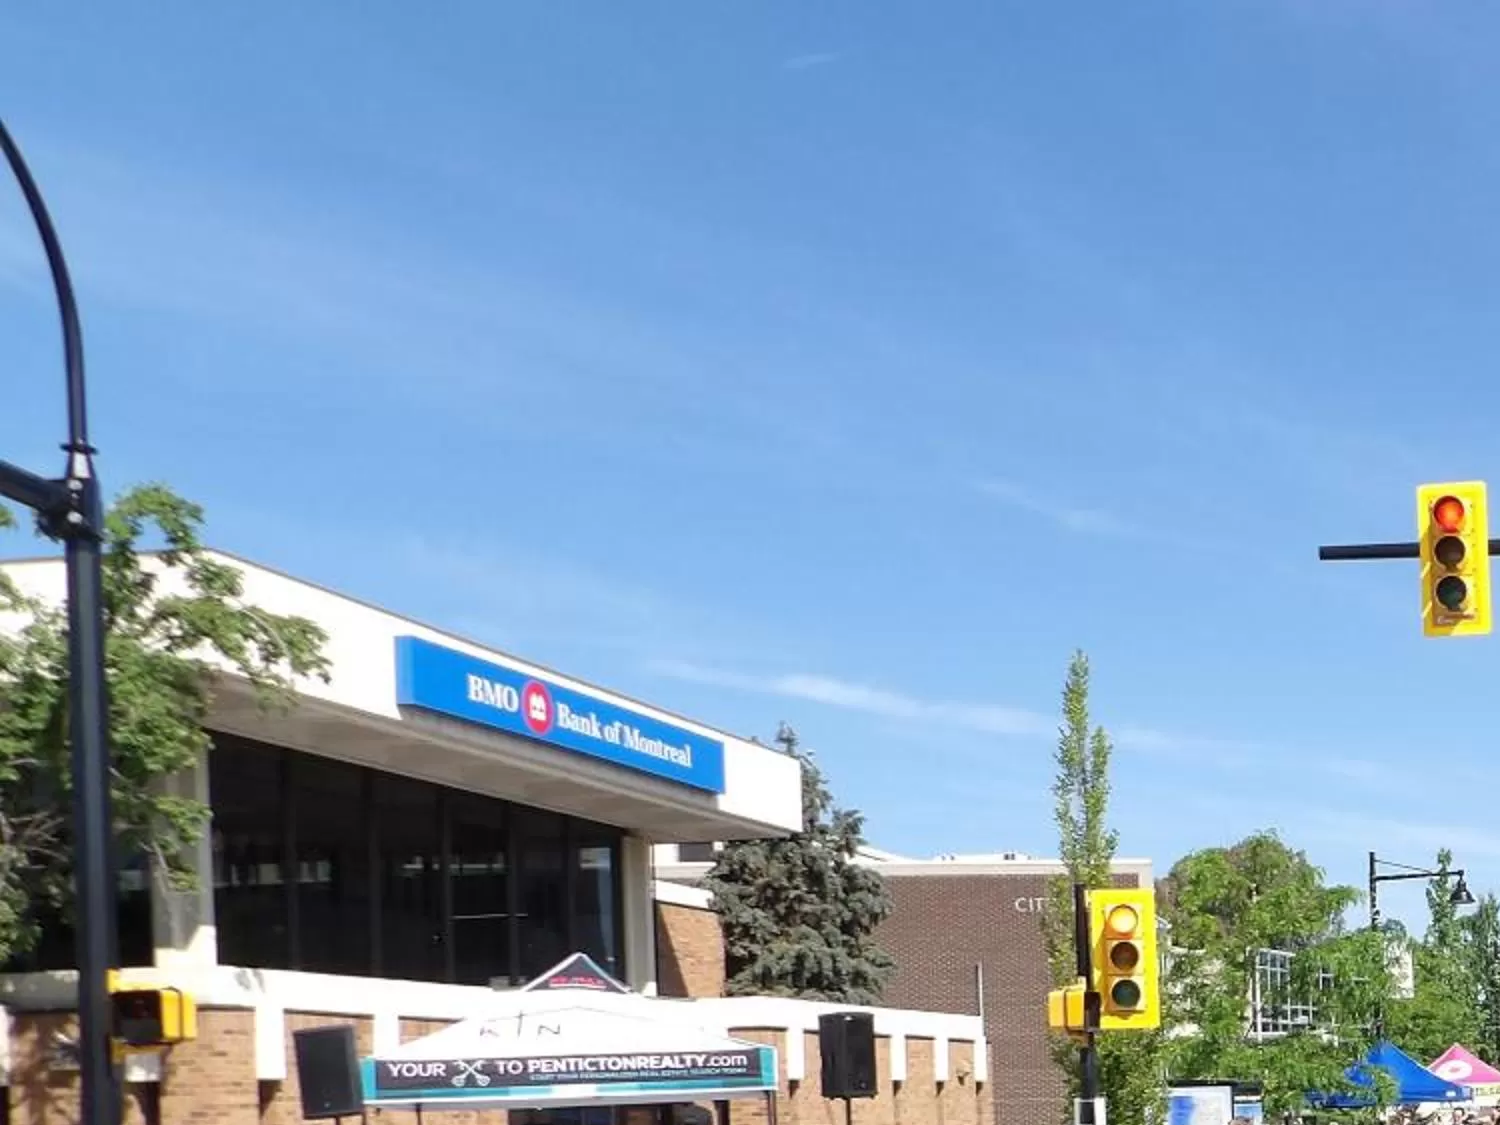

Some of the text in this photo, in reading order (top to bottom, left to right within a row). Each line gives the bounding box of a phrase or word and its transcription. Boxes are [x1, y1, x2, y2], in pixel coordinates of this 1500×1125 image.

[467, 673, 519, 713] BMO
[556, 702, 693, 768] Bank of Montreal
[1013, 897, 1050, 913] CIT
[388, 1053, 747, 1079] YOUR TO PENTICTONREALTY.com
